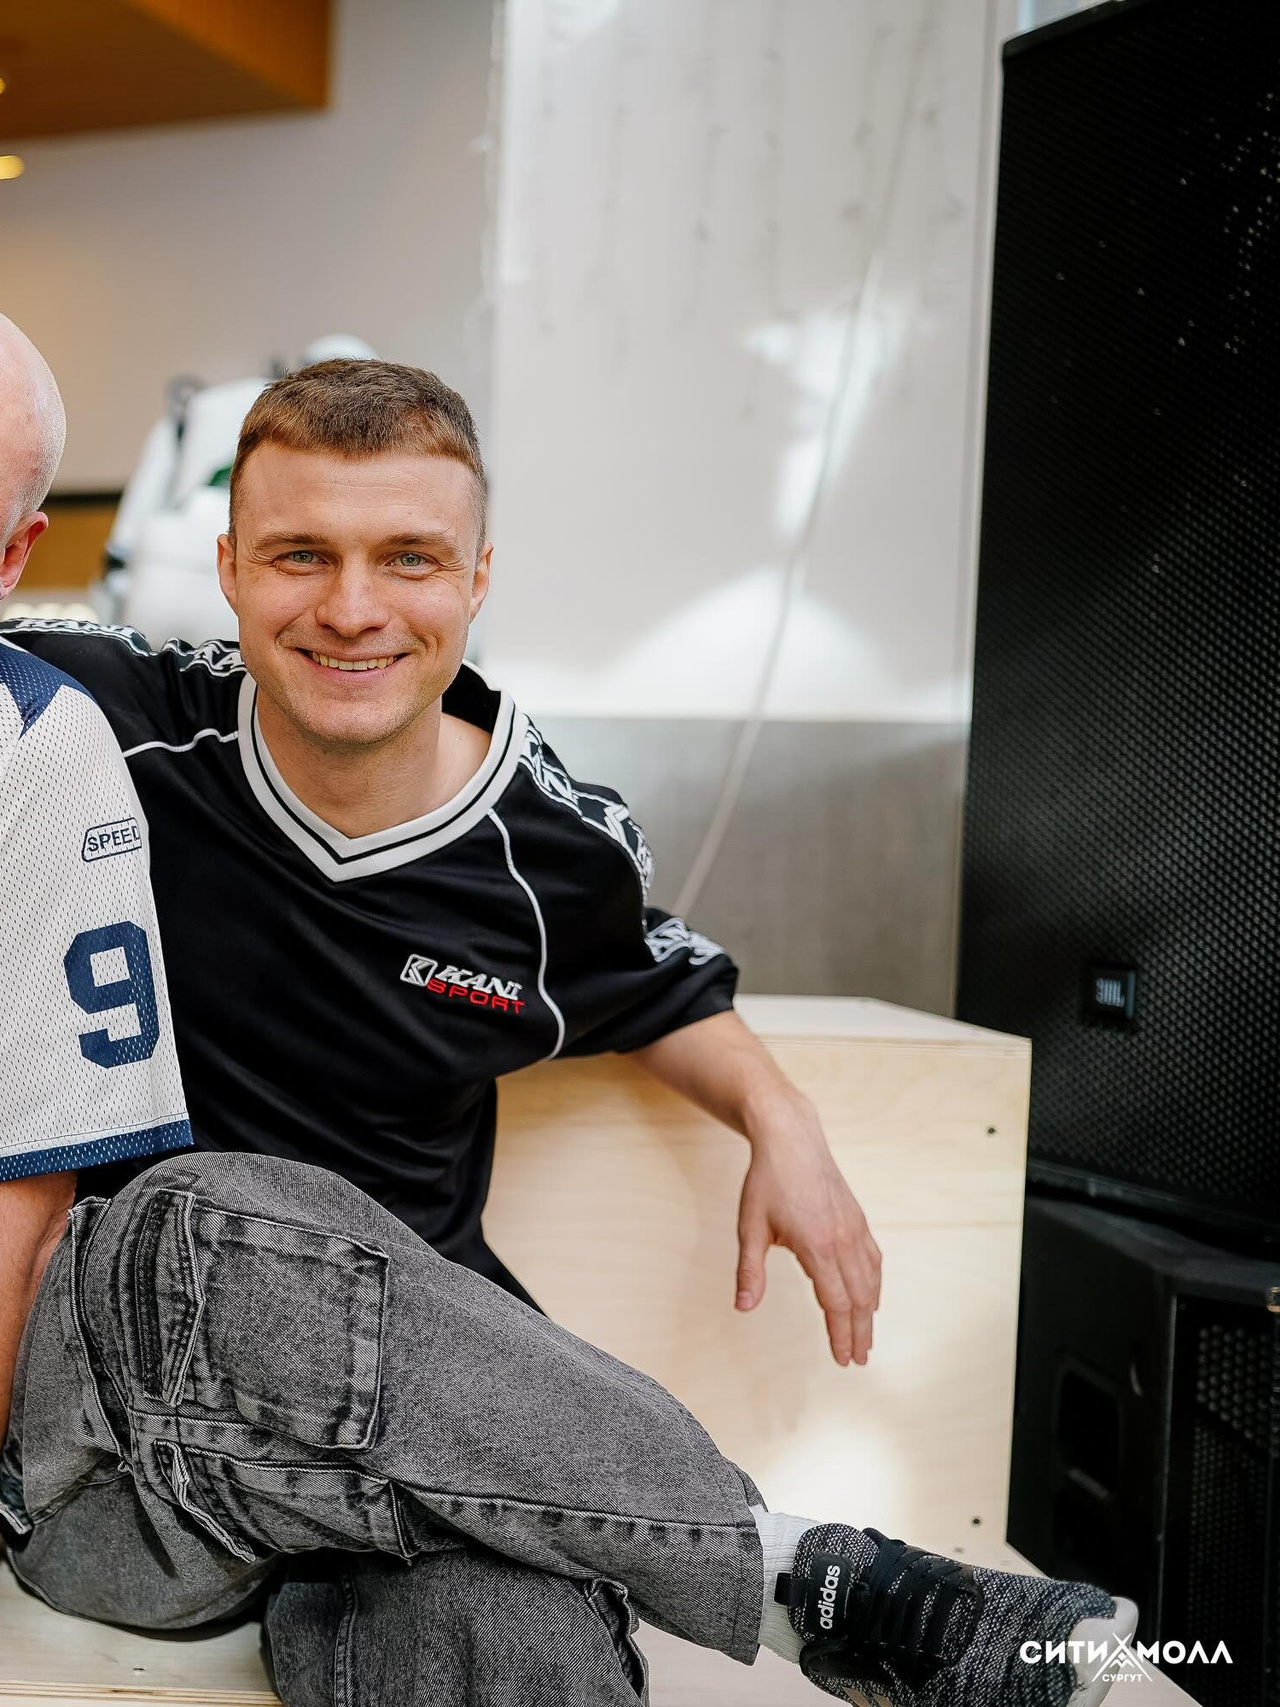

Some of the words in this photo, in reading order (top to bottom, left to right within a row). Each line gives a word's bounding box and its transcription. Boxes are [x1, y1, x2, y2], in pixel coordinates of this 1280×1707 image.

[62, 920, 160, 1069] 9
[426, 977, 525, 1015] SPORT
[434, 964, 523, 1001] KANI
[817, 1564, 841, 1630] adidas
